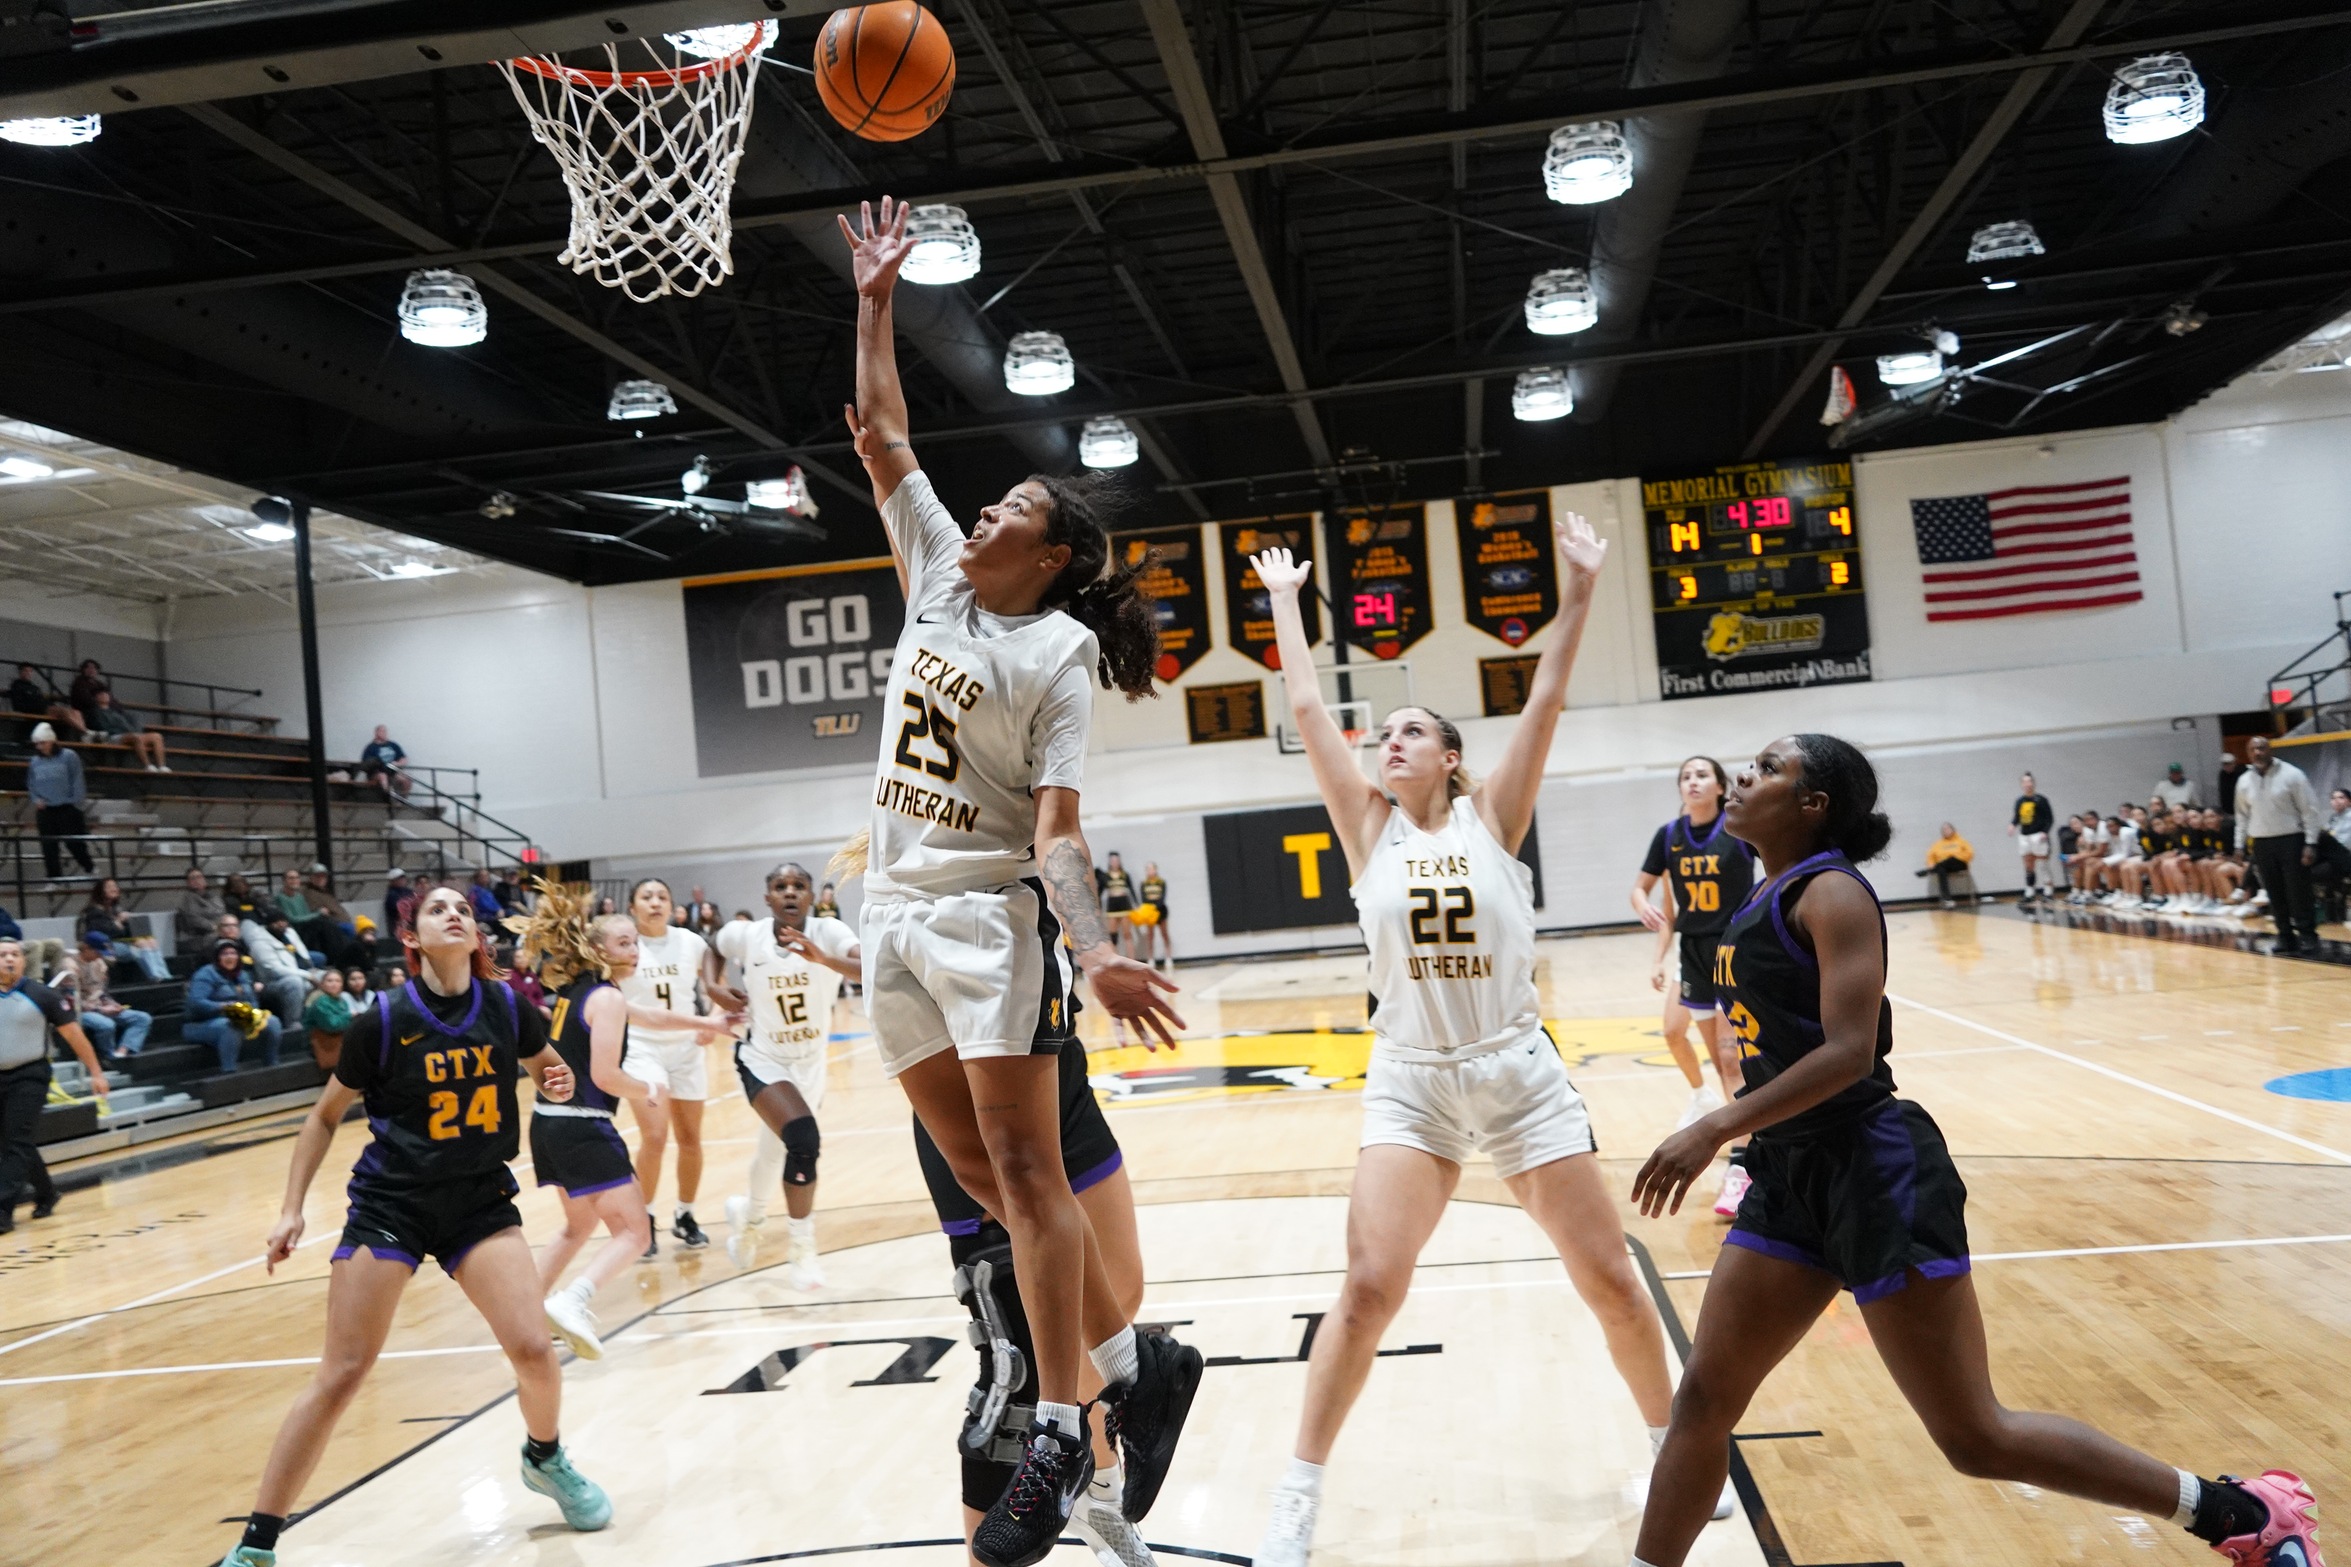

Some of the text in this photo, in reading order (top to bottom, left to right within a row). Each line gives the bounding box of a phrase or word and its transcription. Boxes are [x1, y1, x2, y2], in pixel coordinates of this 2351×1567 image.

[1644, 463, 1852, 505] MEMORIAL GYMNASIUM
[1670, 521, 1700, 552] 14
[1829, 506, 1852, 536] 4
[1750, 532, 1763, 555] 1
[1679, 576, 1698, 599] 3
[1830, 561, 1850, 584] 2
[786, 594, 872, 648] GO
[1353, 592, 1396, 627] 24
[909, 647, 985, 712] TEXAS
[1662, 668, 1707, 695] First
[1821, 656, 1870, 678] Bank
[812, 712, 861, 739] TLU
[894, 688, 961, 784] 25
[1406, 855, 1470, 878] TEXAS
[1679, 854, 1721, 876] CTX
[1684, 881, 1720, 912] 10
[1408, 886, 1476, 945] 22
[642, 963, 680, 979] TEXAS
[768, 972, 810, 990] TEXAS
[655, 982, 672, 1010] 4
[775, 992, 809, 1026] 12
[424, 1044, 497, 1083] CTX
[428, 1084, 502, 1141] 24
